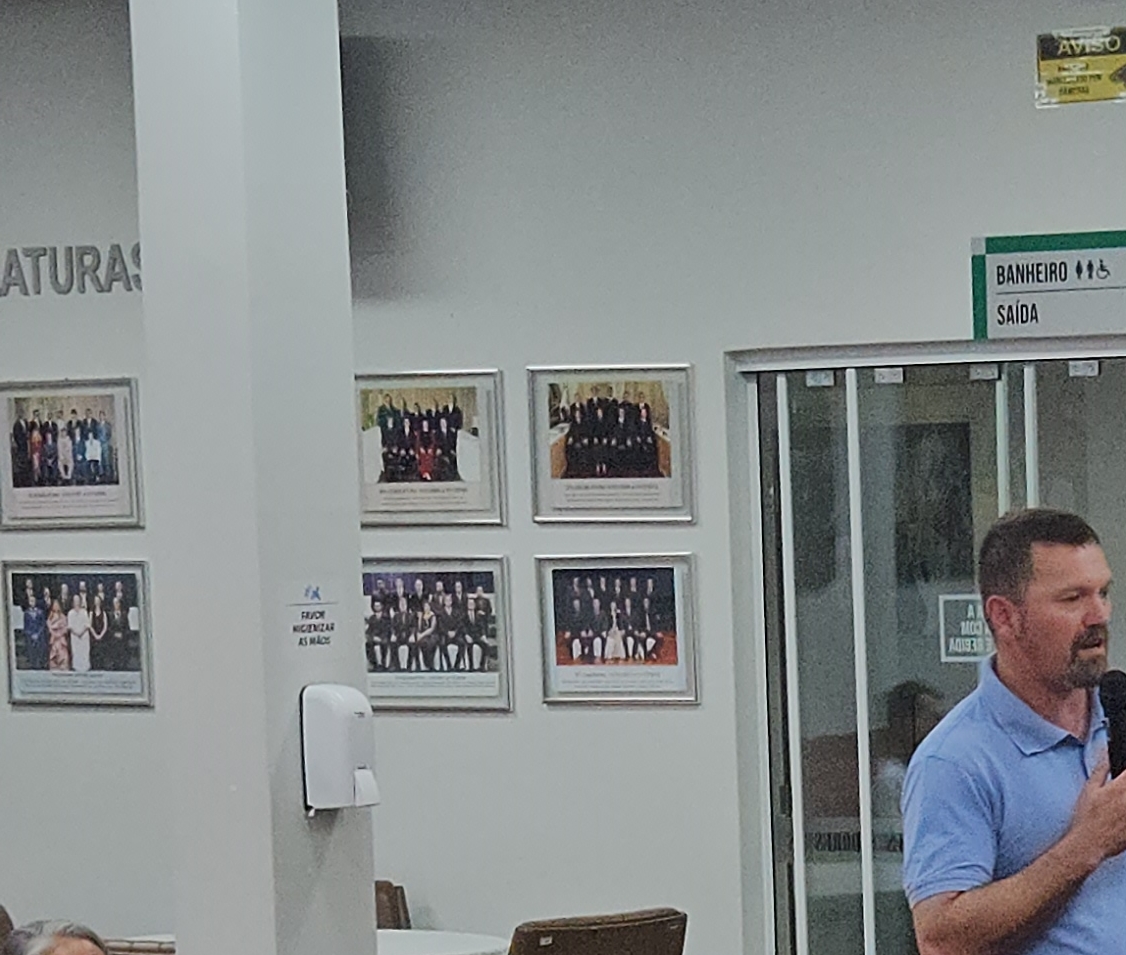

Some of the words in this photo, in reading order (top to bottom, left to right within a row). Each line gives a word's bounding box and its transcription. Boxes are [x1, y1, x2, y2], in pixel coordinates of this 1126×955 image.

[1057, 35, 1121, 56] AVISO
[996, 261, 1068, 286] BANHEIRO
[996, 299, 1039, 326] SAÍDA
[301, 610, 325, 620] FAVOR
[292, 622, 335, 633] HIGIENIZAR
